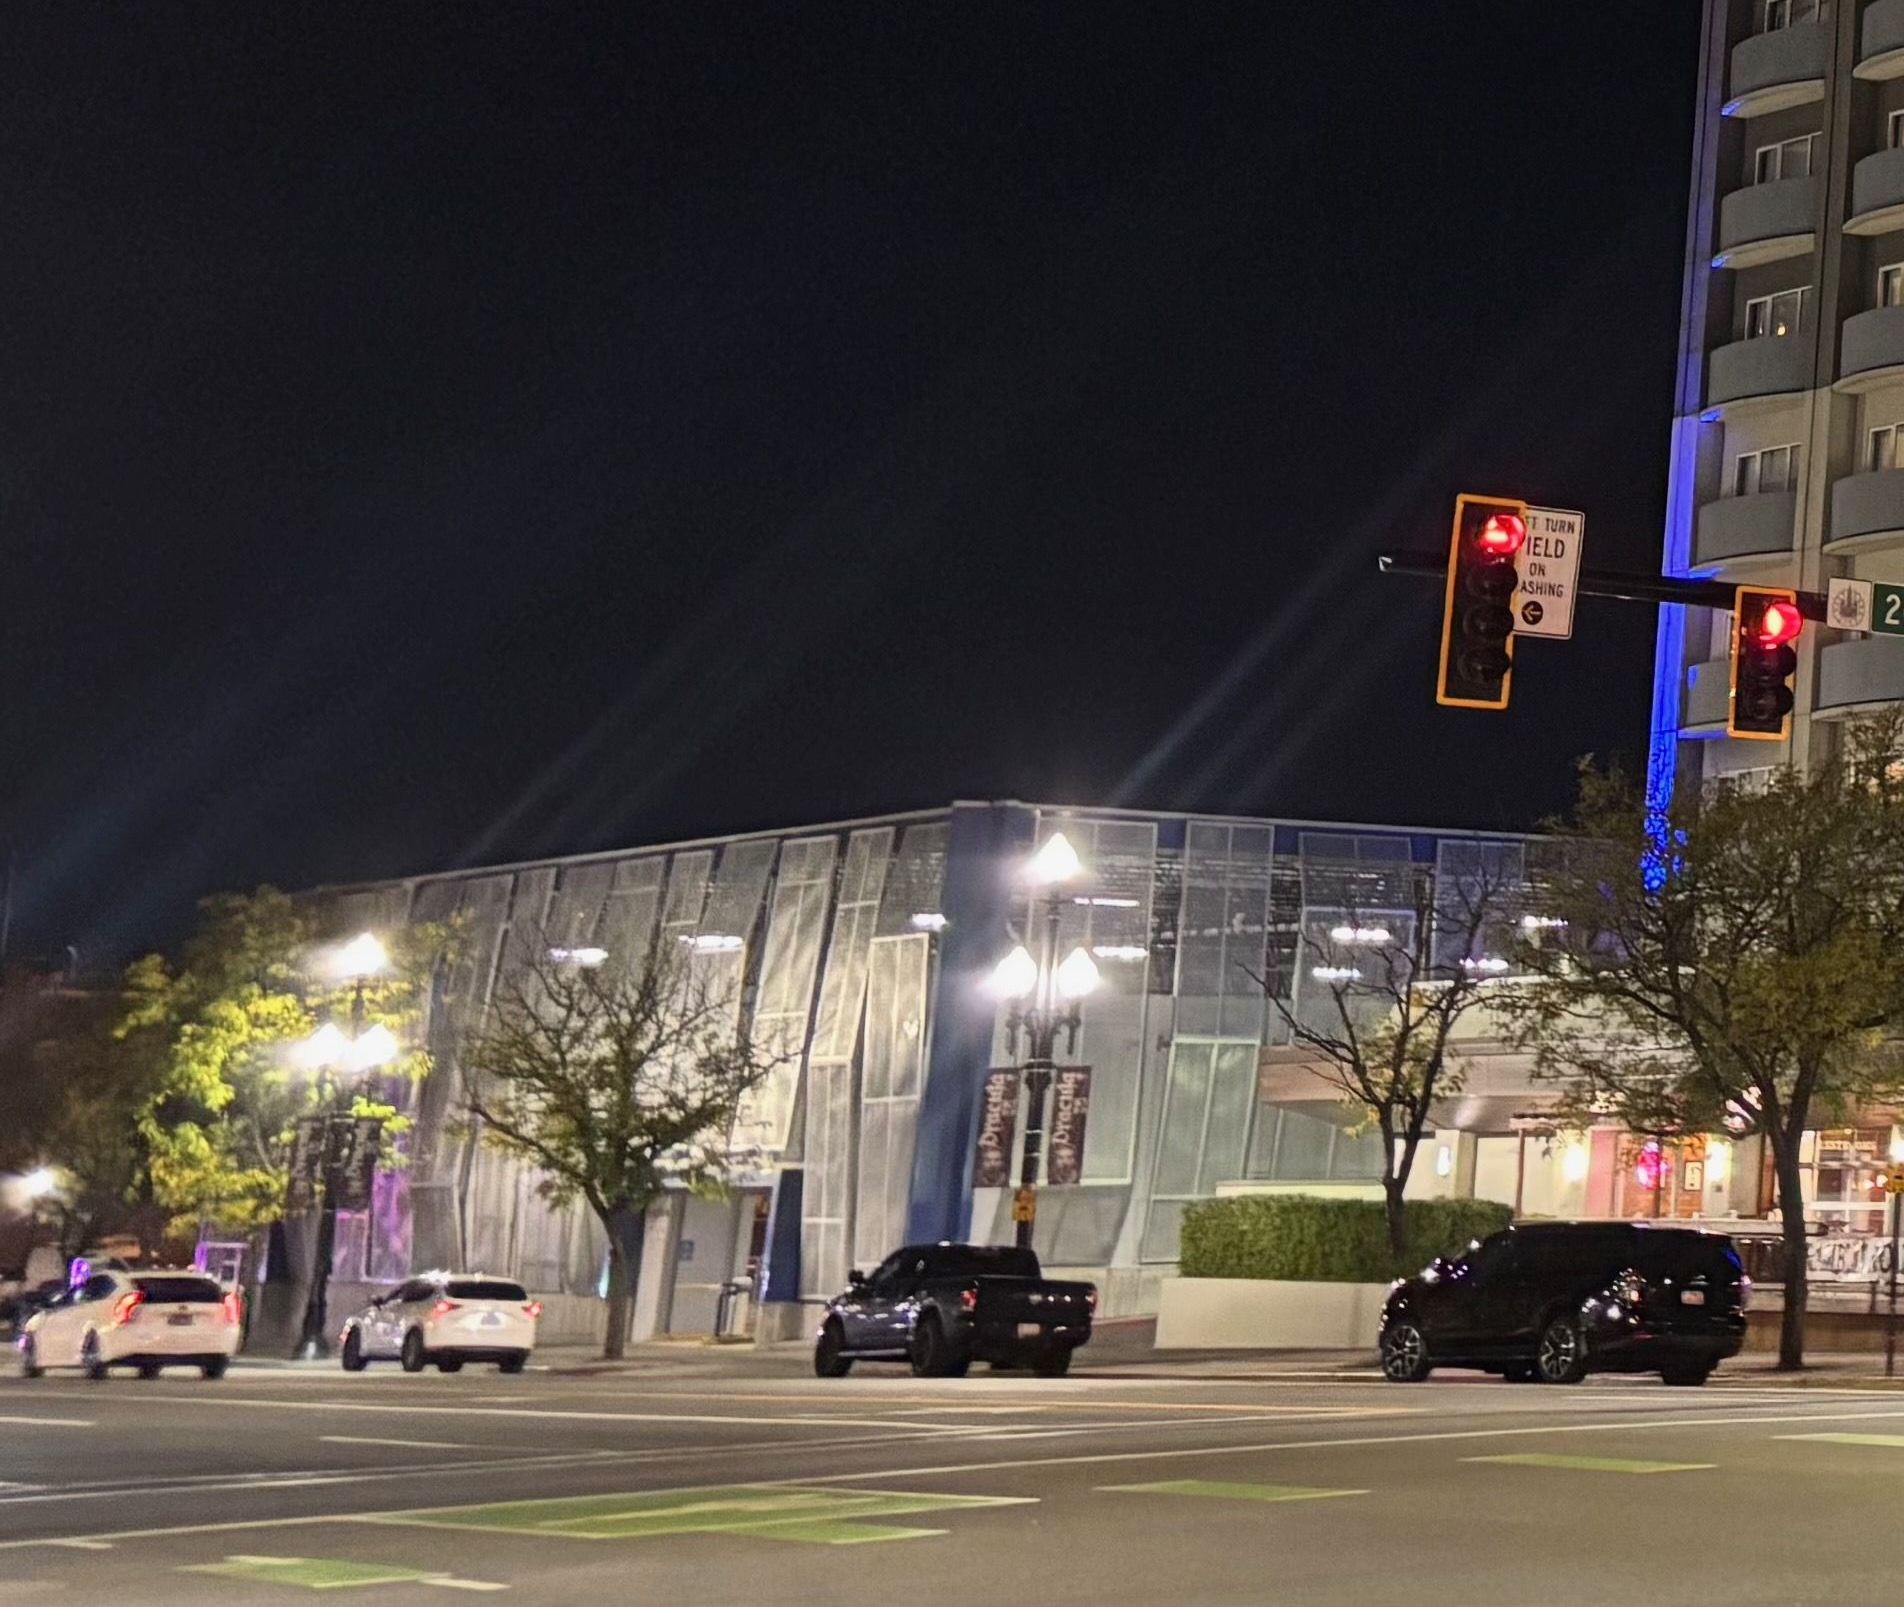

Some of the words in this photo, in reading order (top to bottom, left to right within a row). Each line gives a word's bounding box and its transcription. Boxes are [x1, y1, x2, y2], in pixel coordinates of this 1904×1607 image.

[1545, 518, 1575, 534] TURN
[1527, 536, 1565, 559] IELD
[1529, 562, 1546, 577] ON
[1520, 581, 1564, 598] ASHING
